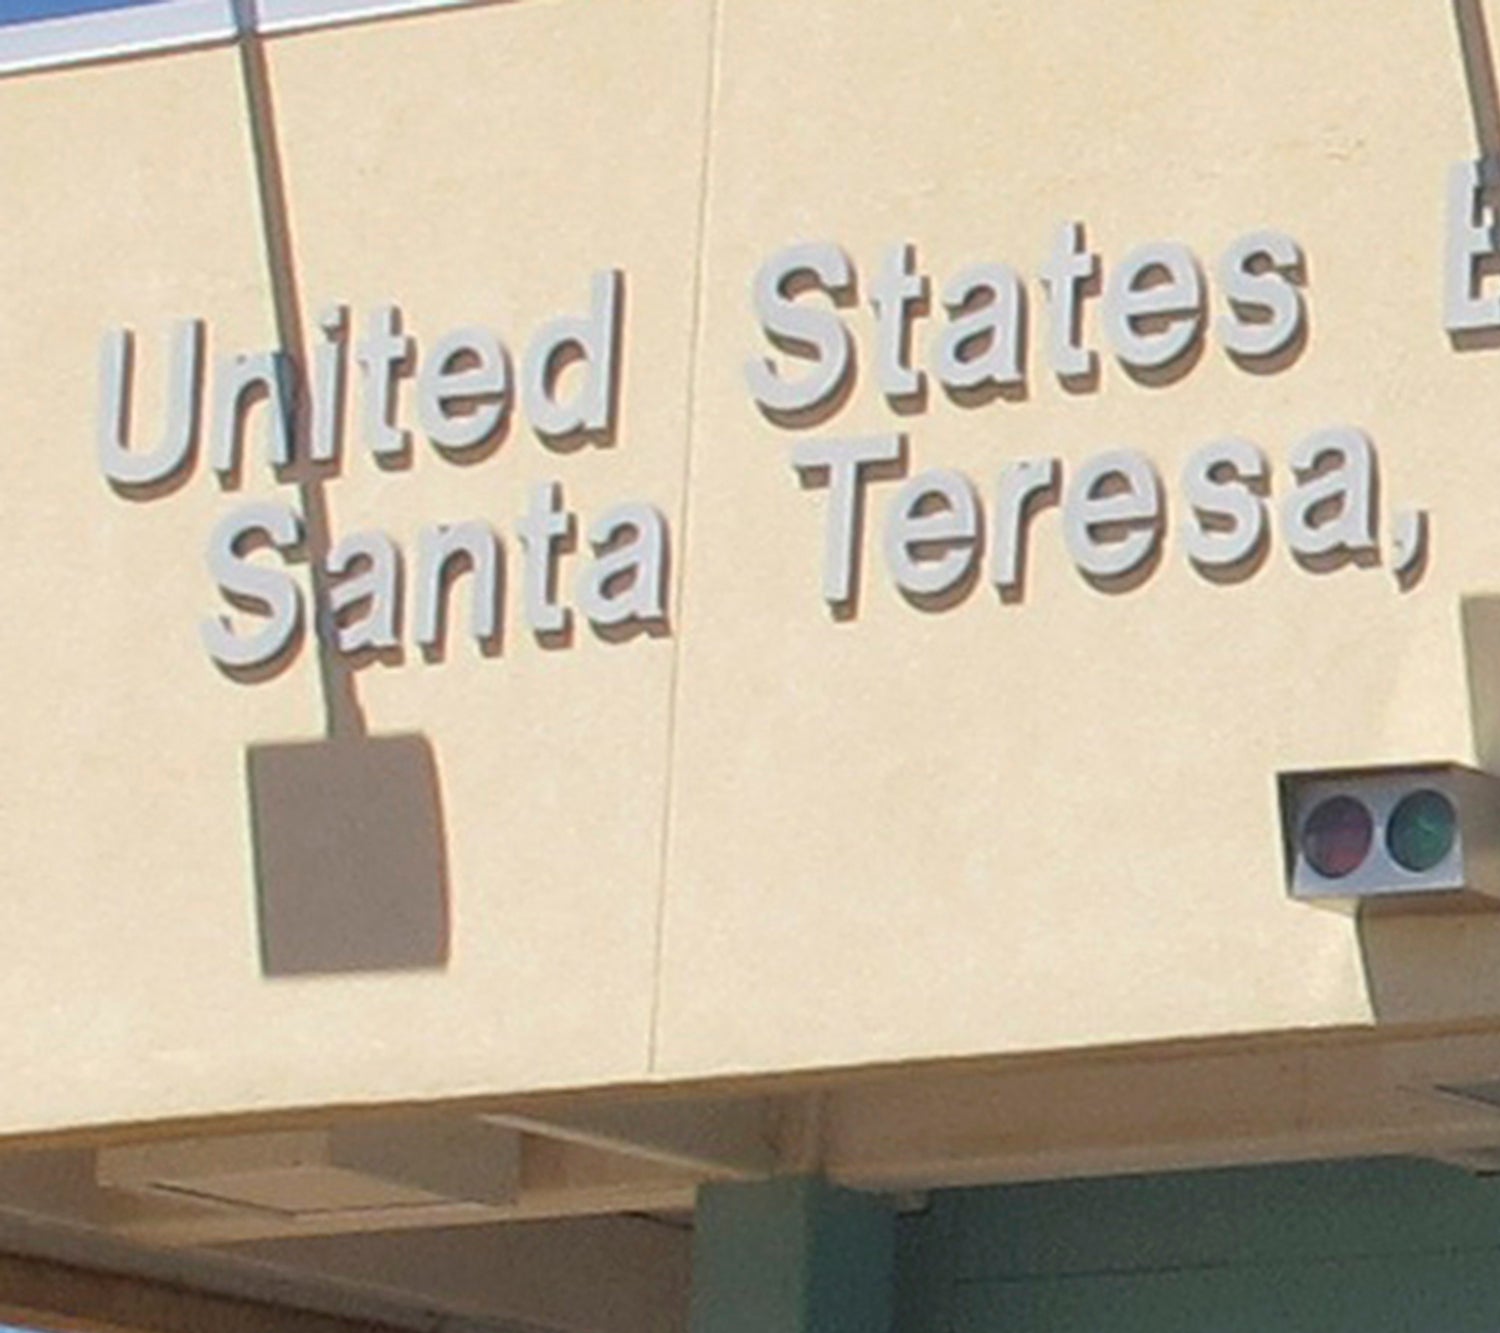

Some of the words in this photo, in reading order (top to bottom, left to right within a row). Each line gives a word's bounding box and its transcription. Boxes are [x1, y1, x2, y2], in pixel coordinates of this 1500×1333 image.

[98, 268, 622, 488] United
[742, 222, 1305, 416] States
[200, 482, 668, 674] Santa
[794, 425, 1427, 608] Teresa,
